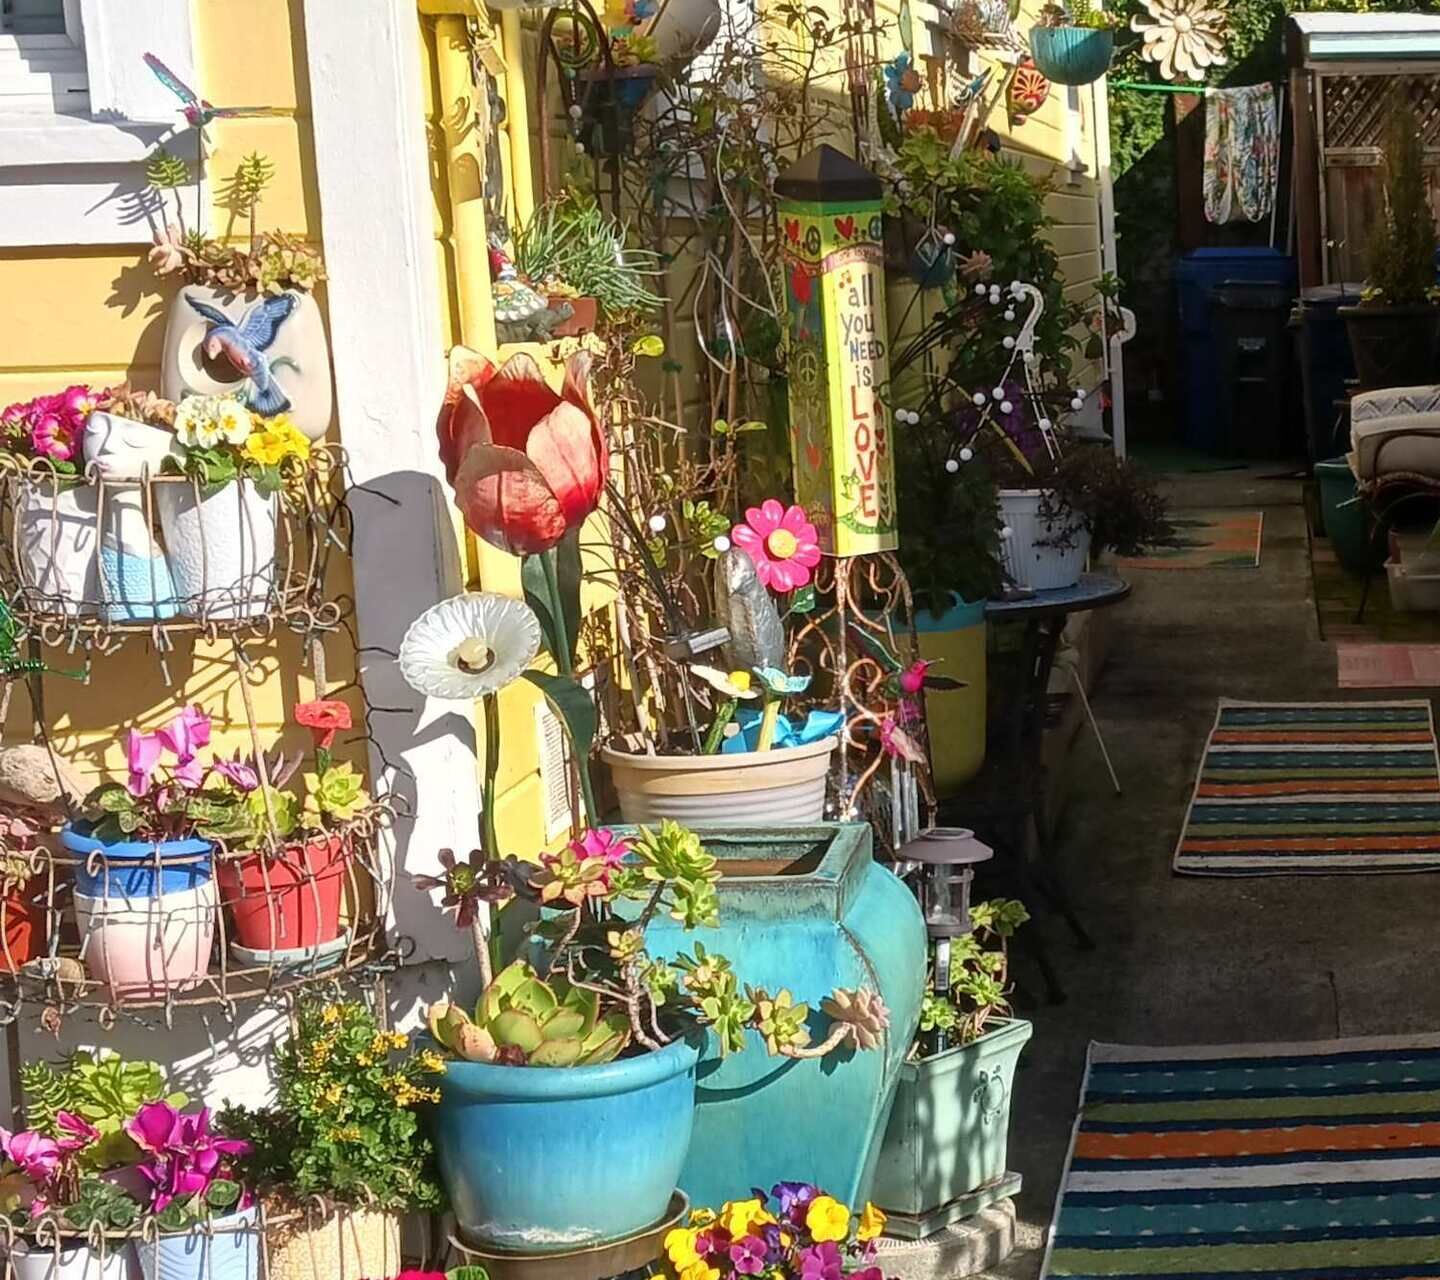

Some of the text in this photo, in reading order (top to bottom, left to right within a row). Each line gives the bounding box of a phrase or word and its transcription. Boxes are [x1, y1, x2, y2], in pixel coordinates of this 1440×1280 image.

[848, 273, 874, 308] all
[849, 338, 885, 362] NEED
[851, 385, 876, 518] LOVE
